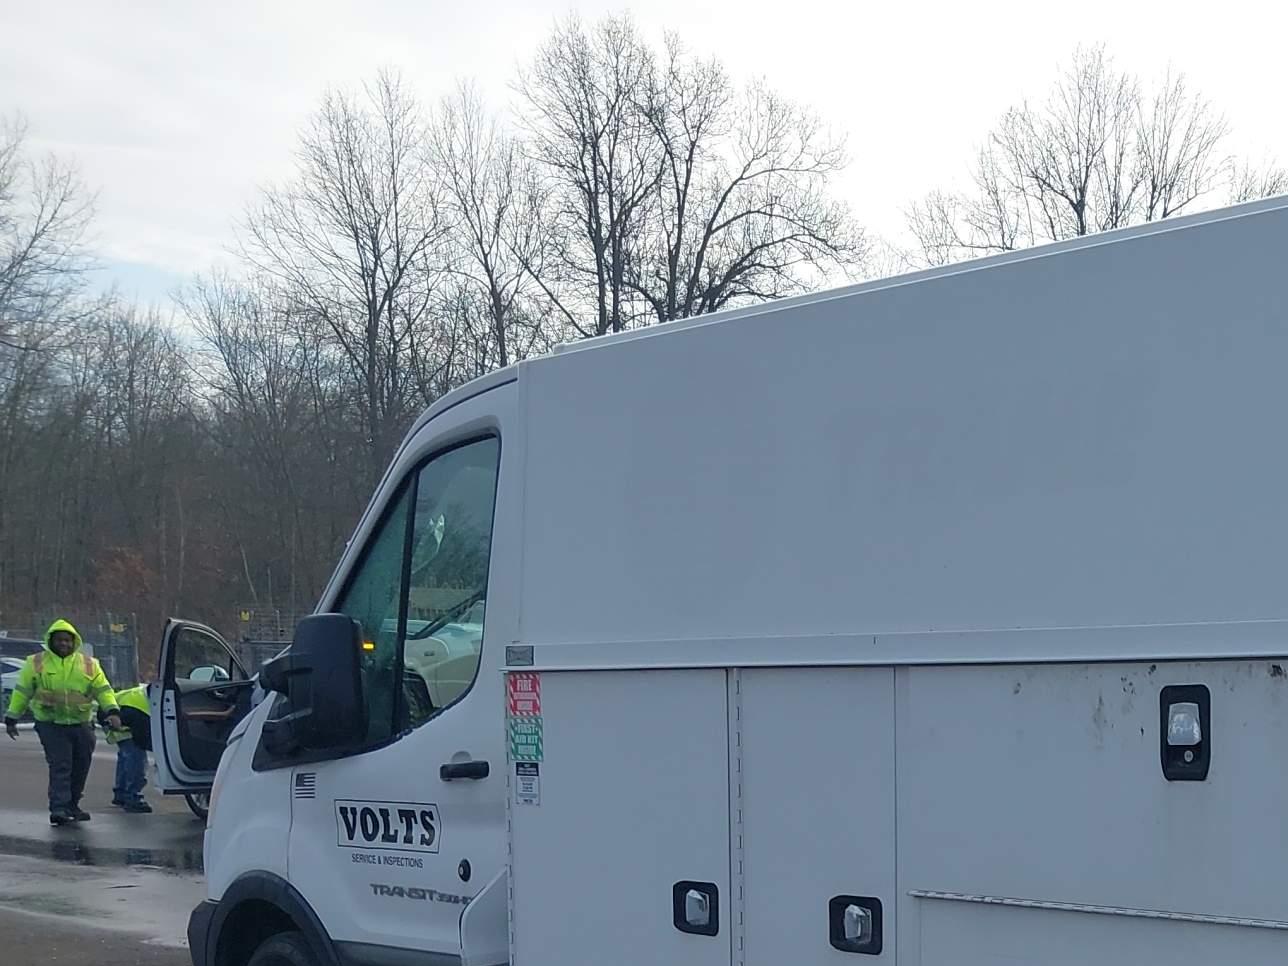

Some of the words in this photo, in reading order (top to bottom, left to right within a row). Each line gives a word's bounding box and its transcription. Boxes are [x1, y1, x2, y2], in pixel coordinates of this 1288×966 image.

[516, 679, 532, 691] FIRE
[339, 806, 435, 846] VOLTS
[351, 853, 377, 865] SERVICE
[383, 855, 424, 869] INSPECTIONS
[369, 883, 437, 901] TRANSIT
